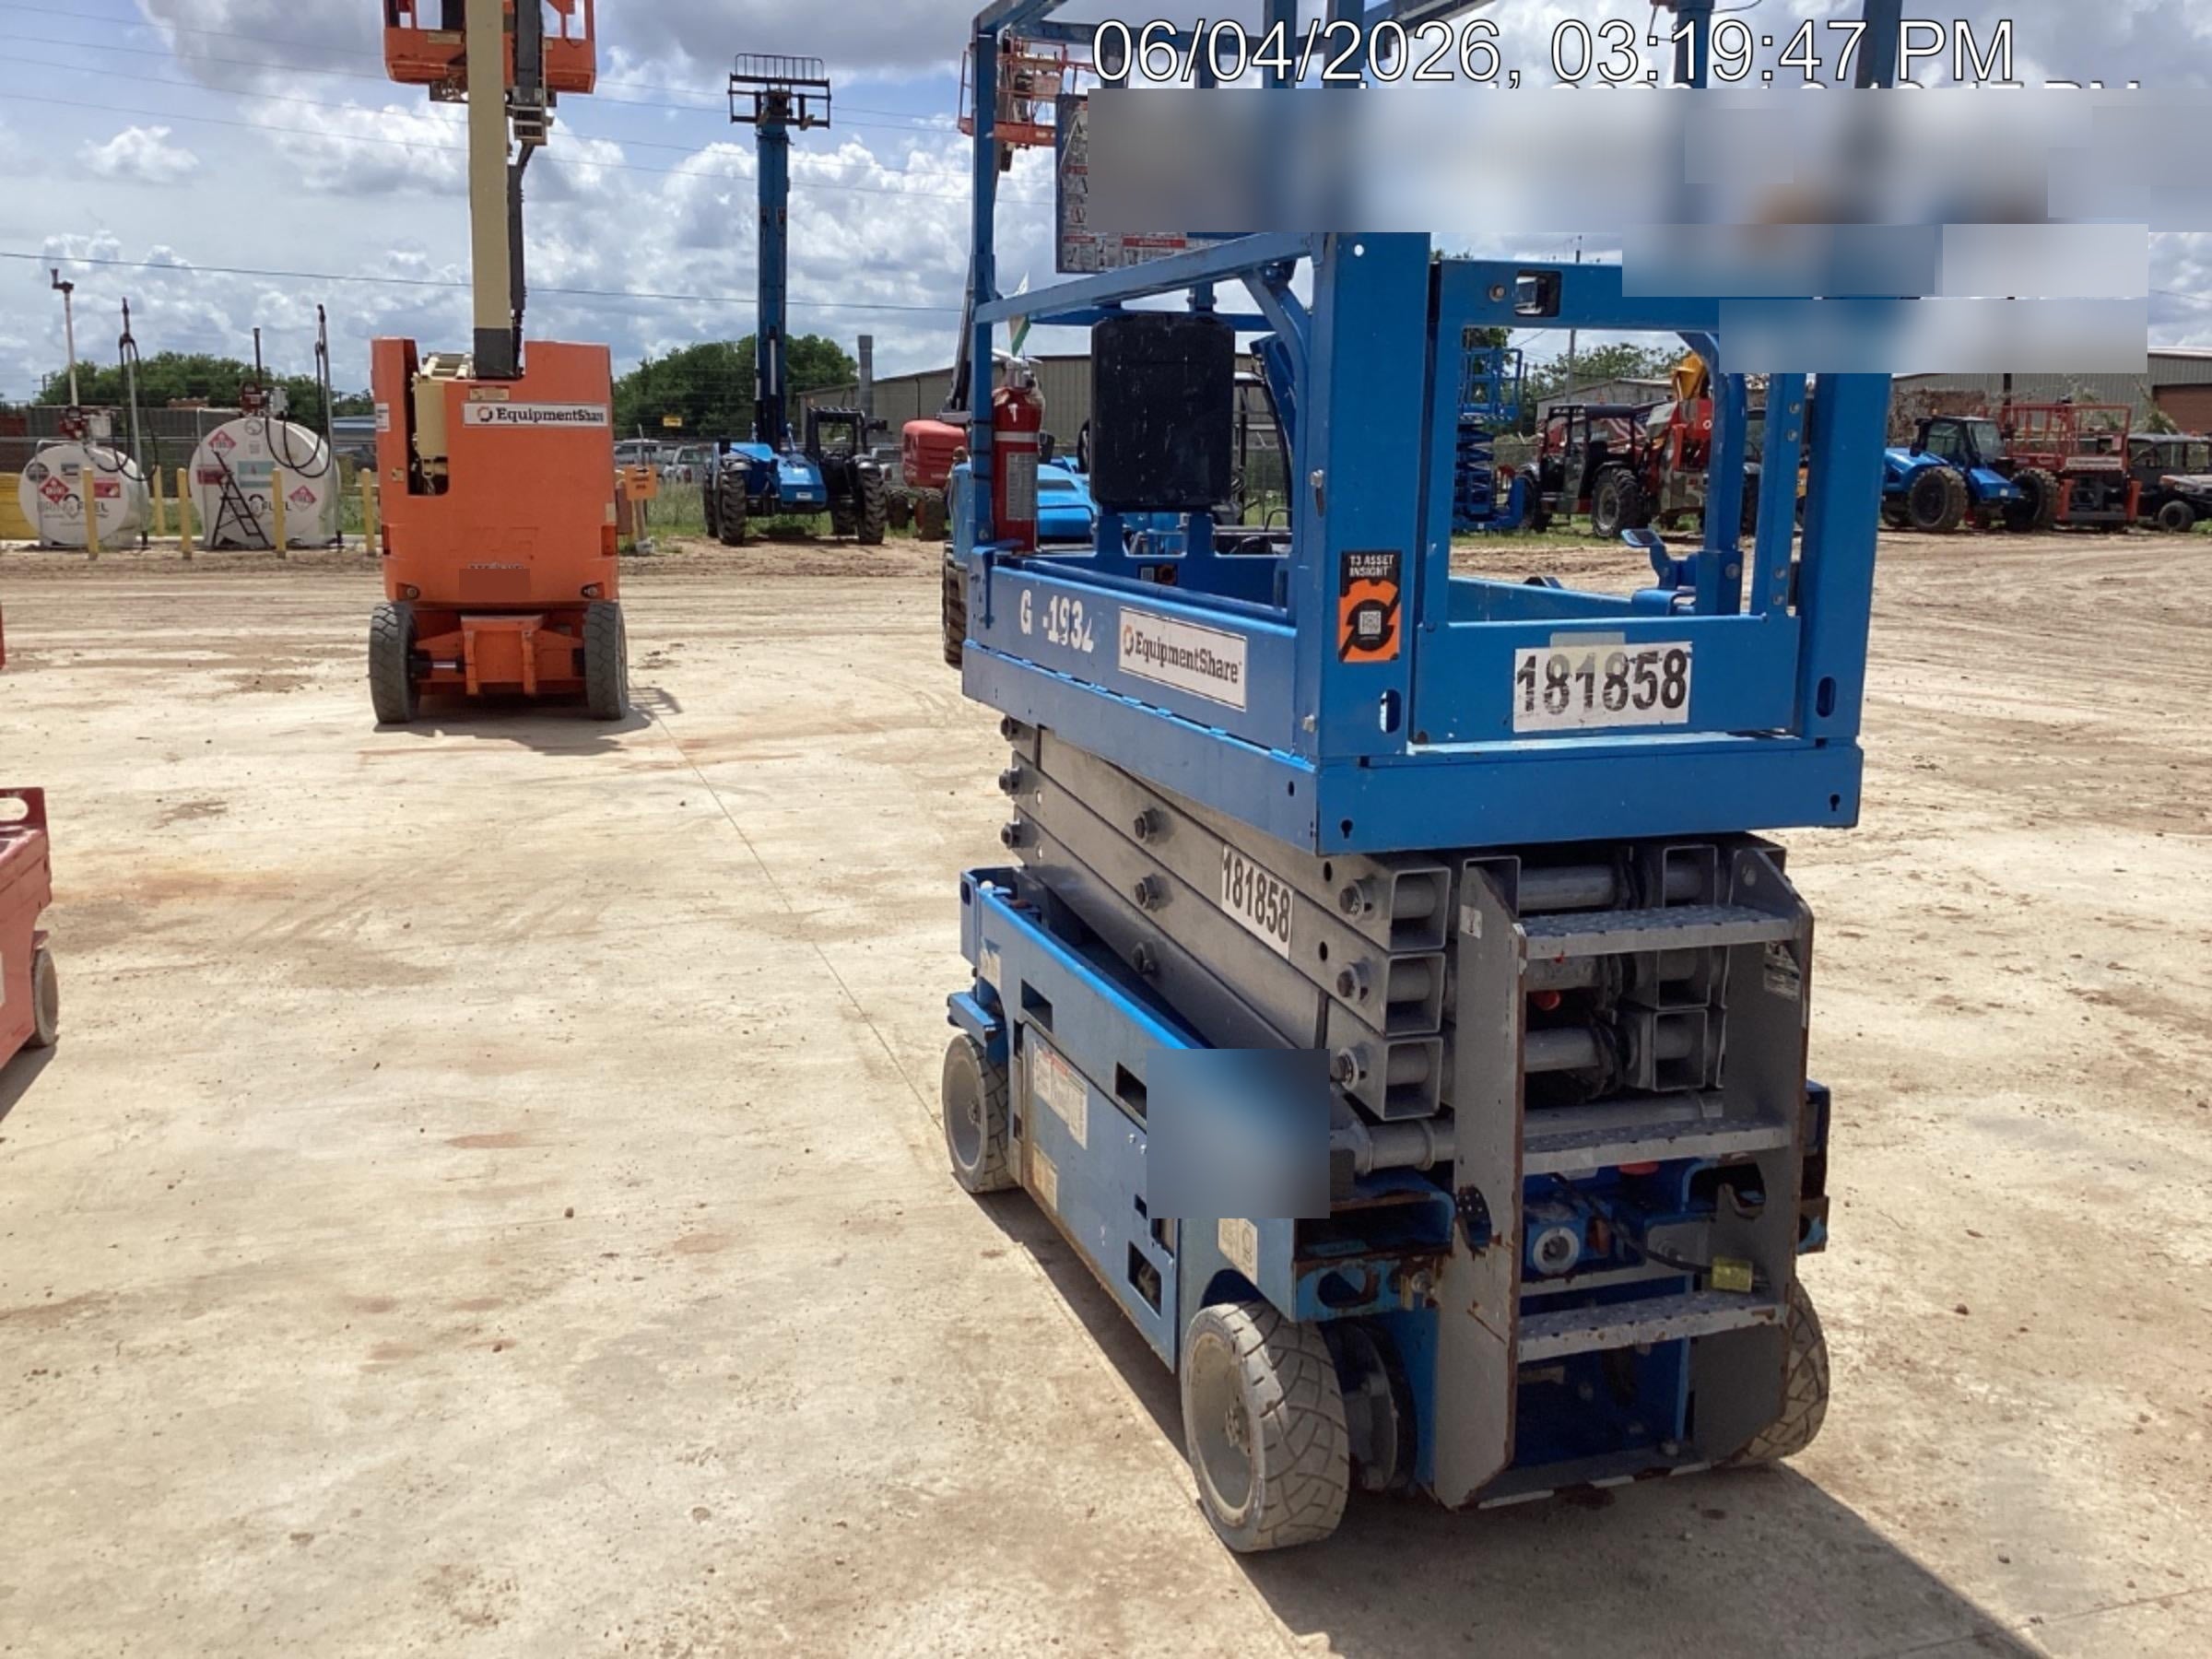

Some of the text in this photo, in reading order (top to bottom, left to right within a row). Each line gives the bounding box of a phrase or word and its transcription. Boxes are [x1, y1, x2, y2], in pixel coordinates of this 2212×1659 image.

[1349, 555, 1394, 566] T3 ASSET
[1349, 566, 1387, 577] INSIGHT
[1020, 589, 1032, 635] G
[1135, 630, 1239, 684] EquipmentShare
[1517, 648, 1688, 715] 181858
[1224, 851, 1290, 943] 181858
